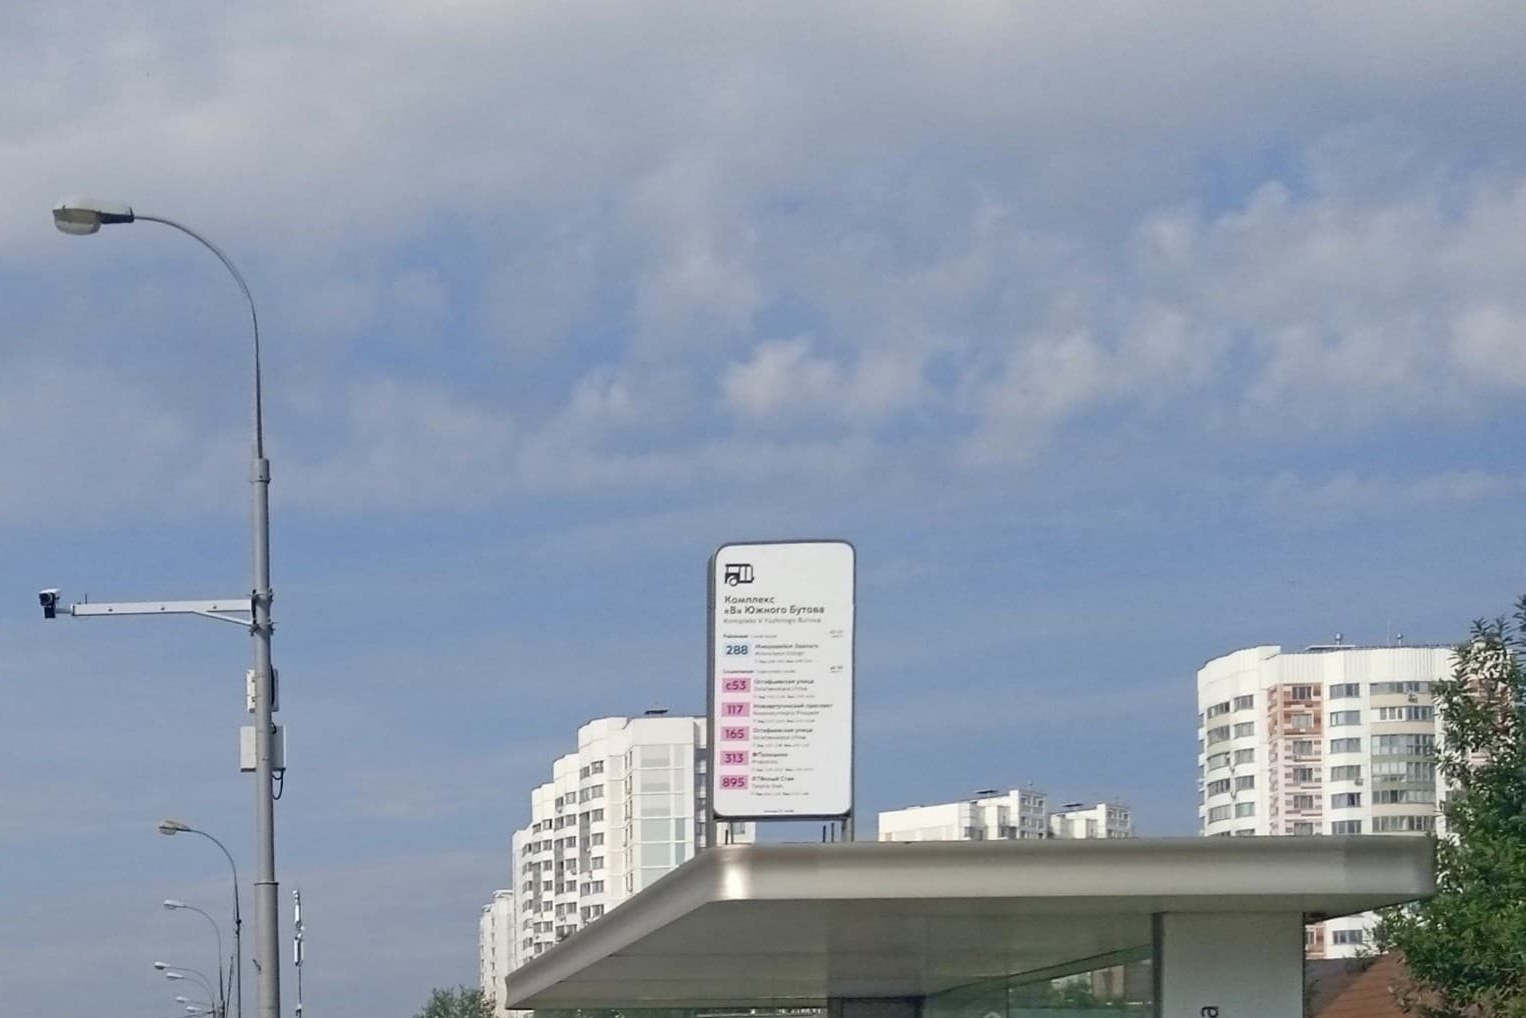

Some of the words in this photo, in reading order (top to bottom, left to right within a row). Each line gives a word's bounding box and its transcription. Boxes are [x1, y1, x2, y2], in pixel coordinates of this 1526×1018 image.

[724, 595, 775, 604] Комплекс
[744, 605, 788, 614] Южного
[789, 604, 825, 616] Бутова
[726, 645, 749, 655] 288
[727, 704, 744, 715] 117
[725, 729, 745, 739] 165
[725, 753, 744, 763] 313
[722, 777, 745, 787] 895
